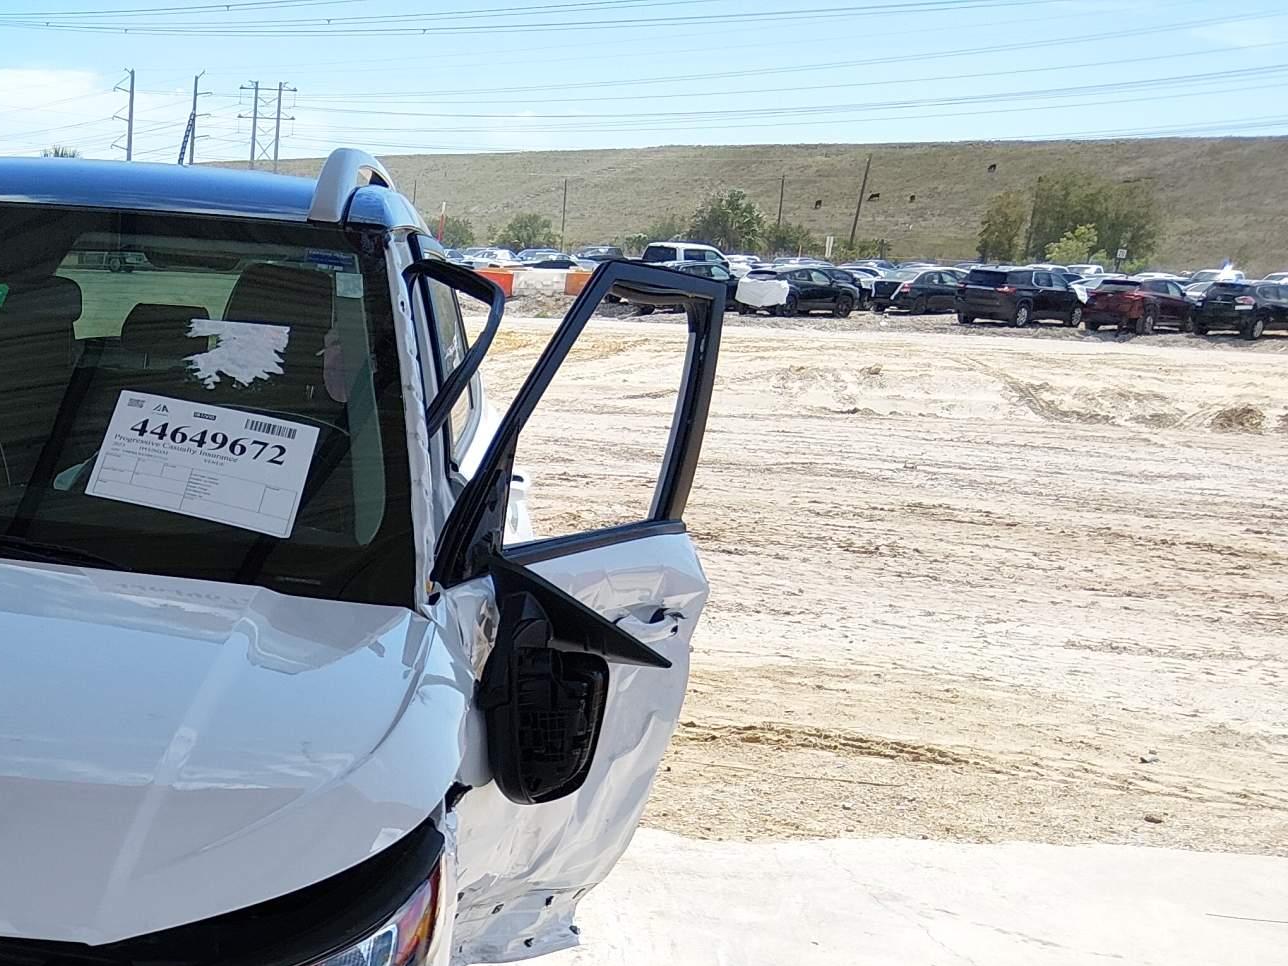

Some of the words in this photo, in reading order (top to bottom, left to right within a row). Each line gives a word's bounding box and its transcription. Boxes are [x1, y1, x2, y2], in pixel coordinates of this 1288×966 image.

[114, 433, 161, 448] Progressive
[162, 441, 198, 456] Casualty
[198, 449, 239, 464] Insurance
[130, 417, 288, 466] 44649672
